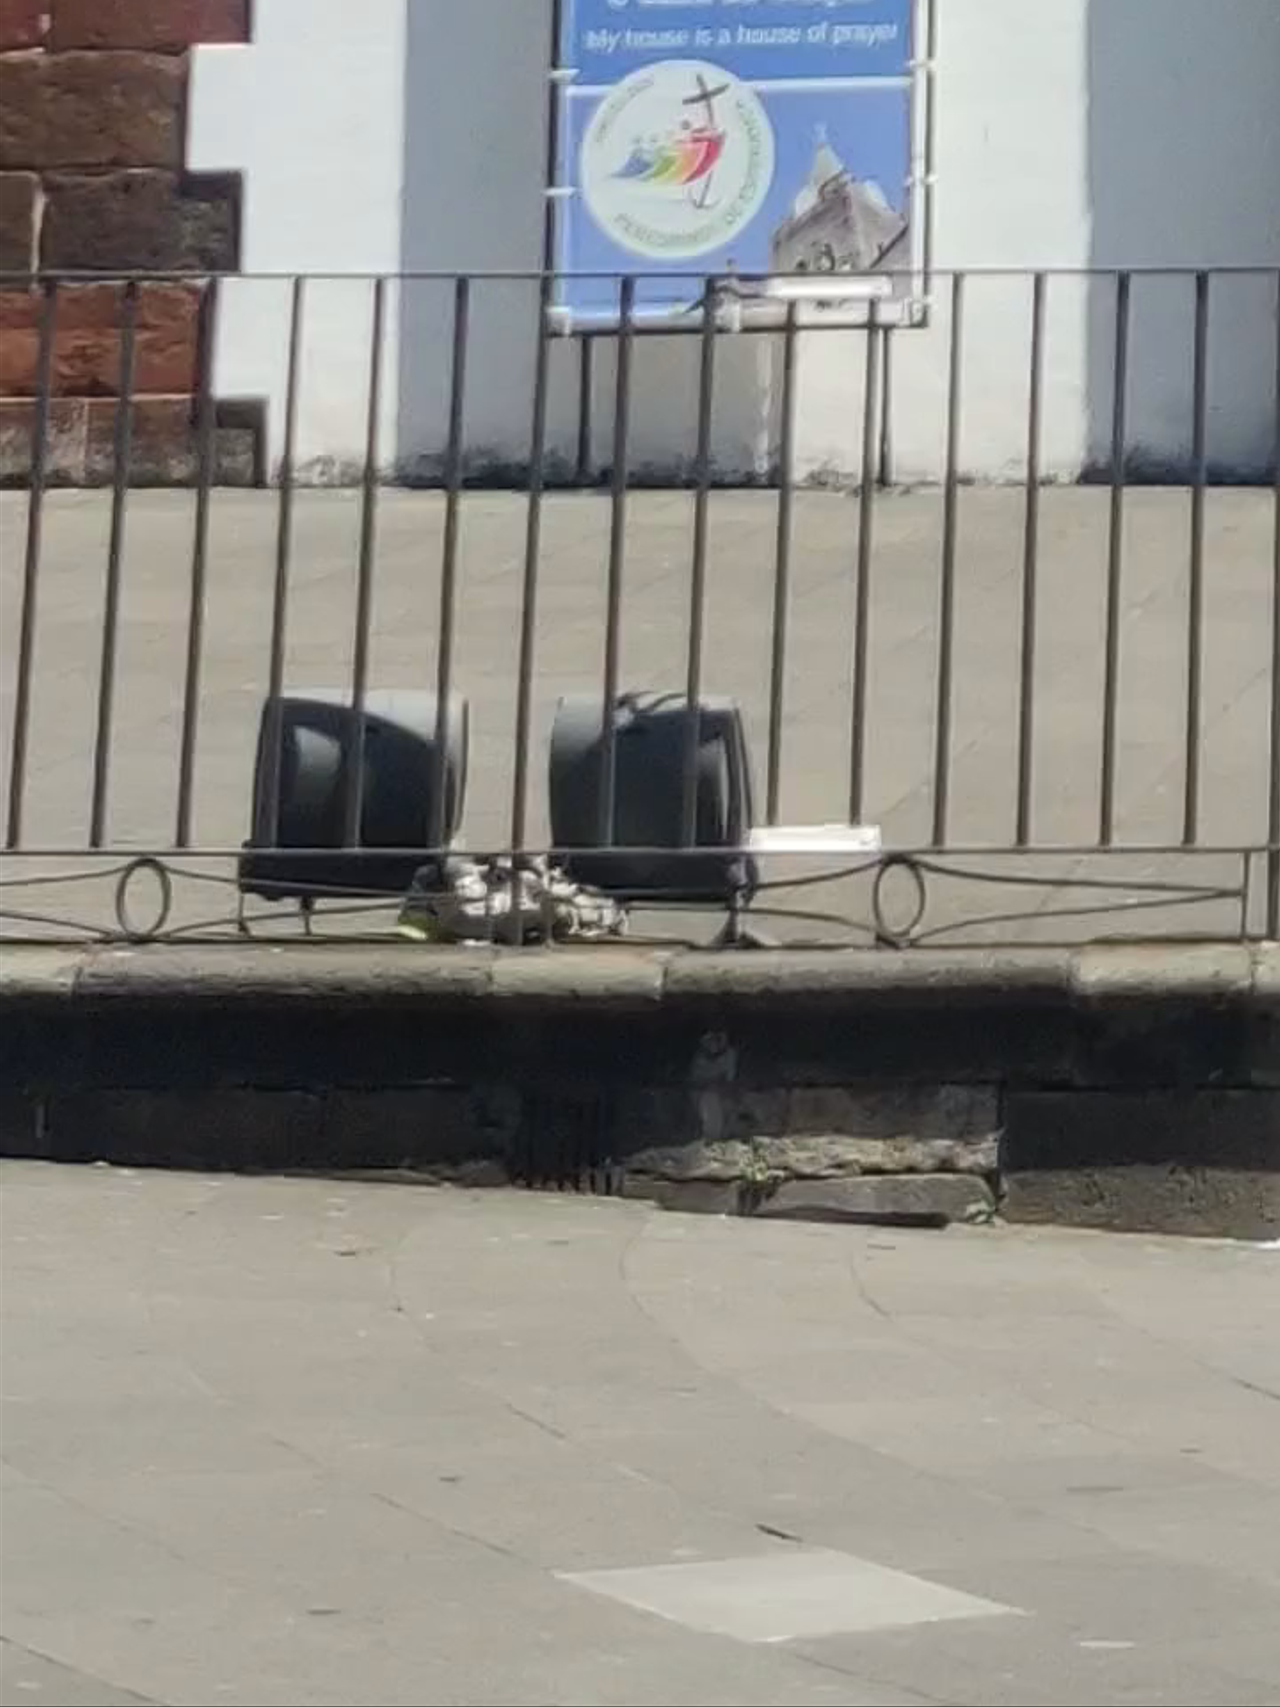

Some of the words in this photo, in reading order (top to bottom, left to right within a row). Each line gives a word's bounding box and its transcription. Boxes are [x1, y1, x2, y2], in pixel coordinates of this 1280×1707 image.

[586, 29, 621, 52] My
[626, 27, 687, 47] house
[695, 26, 712, 45] is
[719, 28, 732, 45] a
[737, 23, 800, 44] house
[807, 22, 829, 44] of
[833, 22, 898, 48] prayer
